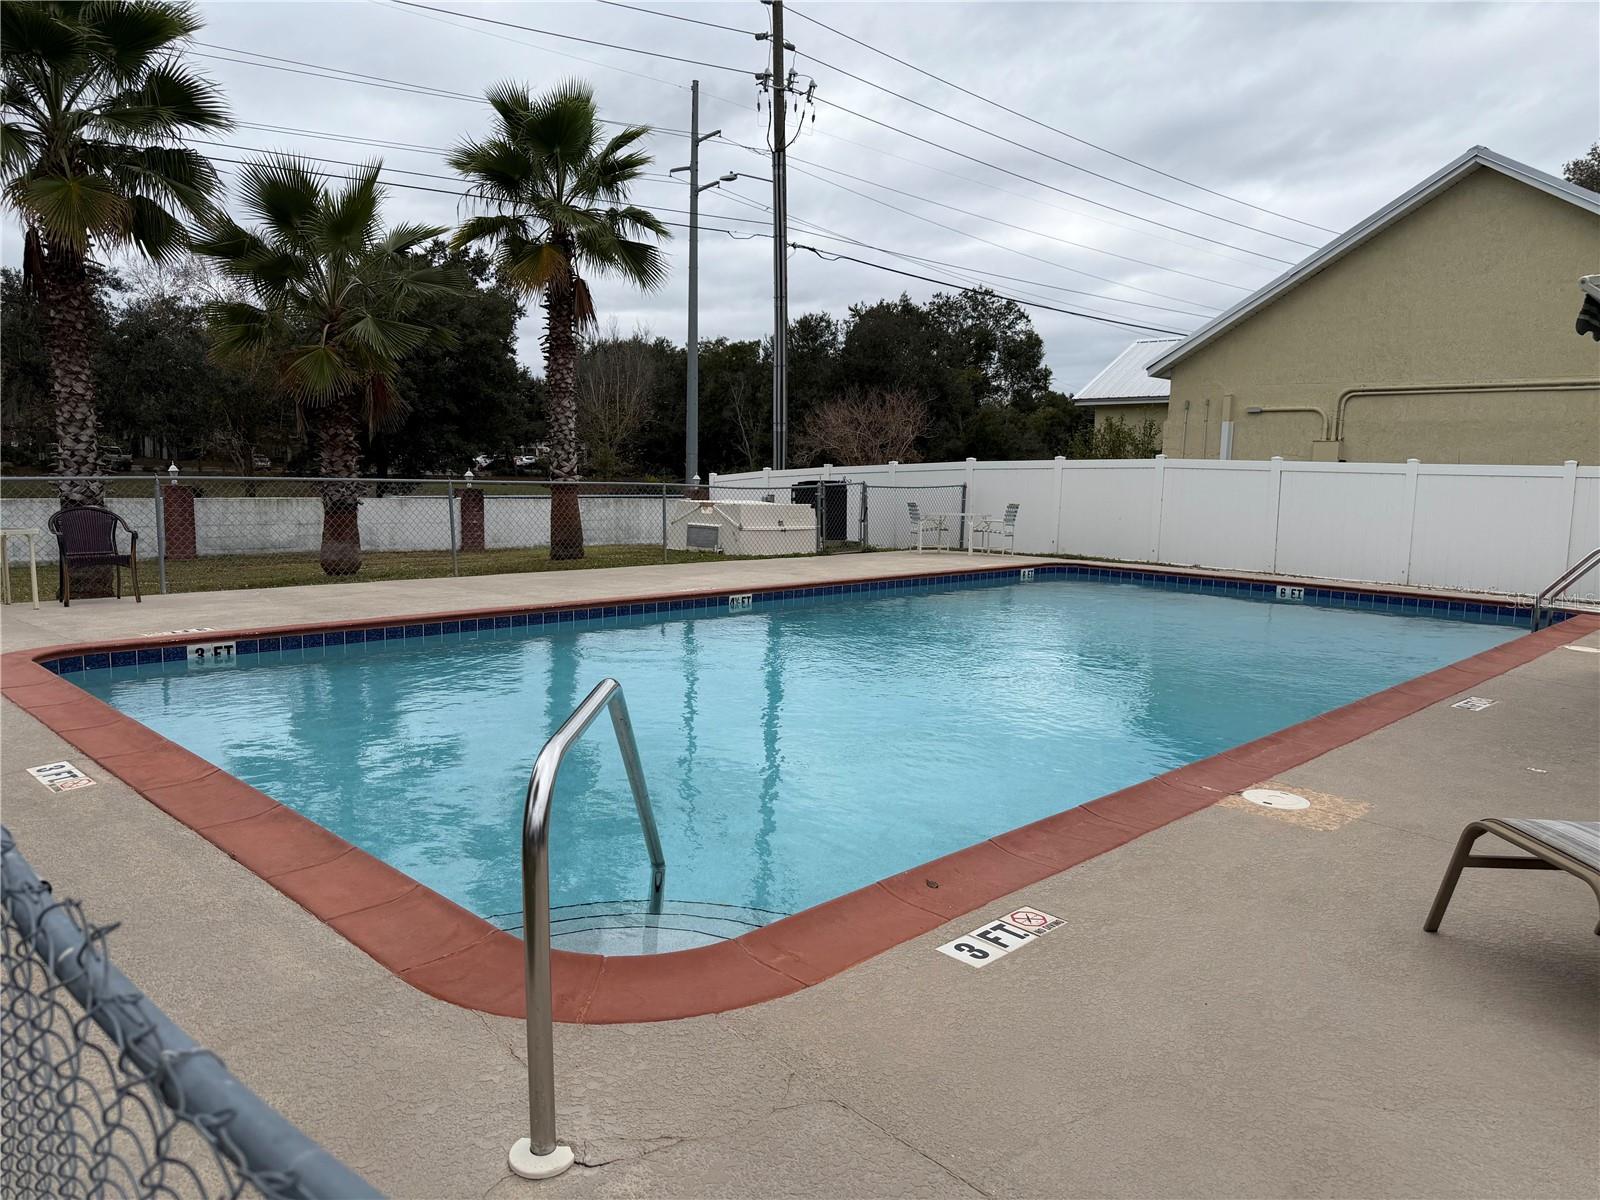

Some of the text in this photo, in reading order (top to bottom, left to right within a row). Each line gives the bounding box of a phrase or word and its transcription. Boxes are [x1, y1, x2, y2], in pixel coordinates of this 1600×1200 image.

[36, 764, 66, 773] 3
[953, 923, 1030, 960] 3 FT.
